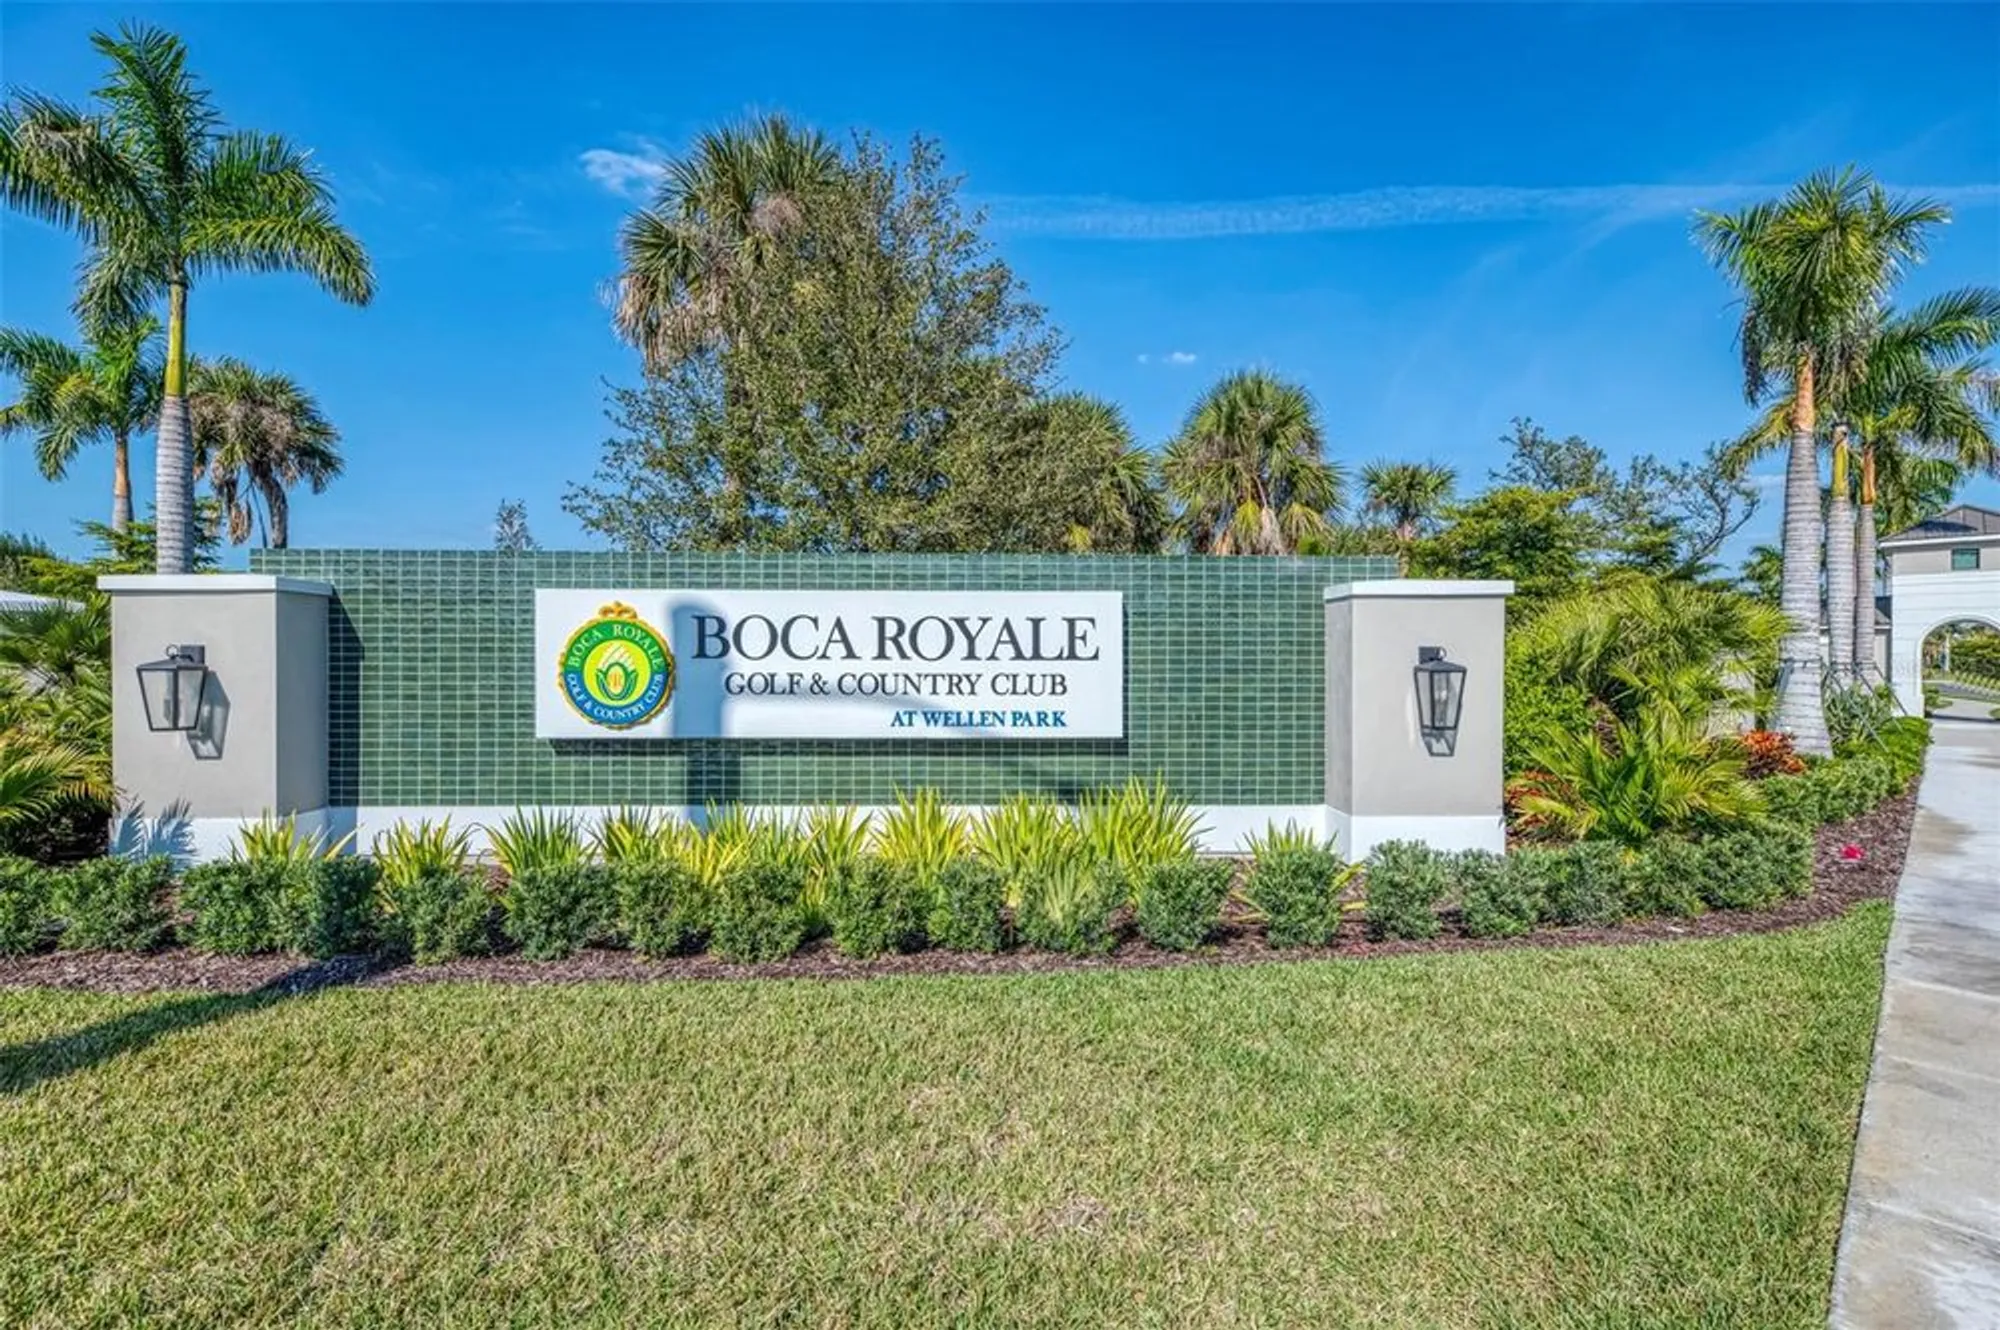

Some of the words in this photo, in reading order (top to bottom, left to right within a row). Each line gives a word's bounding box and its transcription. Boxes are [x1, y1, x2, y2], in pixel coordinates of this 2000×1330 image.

[568, 629, 602, 667] BOCA
[612, 624, 663, 670] ROYALE
[691, 614, 861, 661] BOCA
[871, 616, 1100, 662] ROYALE
[725, 672, 803, 695] GOLF
[809, 673, 829, 695] &
[837, 672, 983, 696] COUNTRY
[990, 673, 1068, 695] CLUB
[890, 711, 918, 727] AT
[922, 711, 1006, 728] WELLEN
[1011, 711, 1067, 727] PARK
